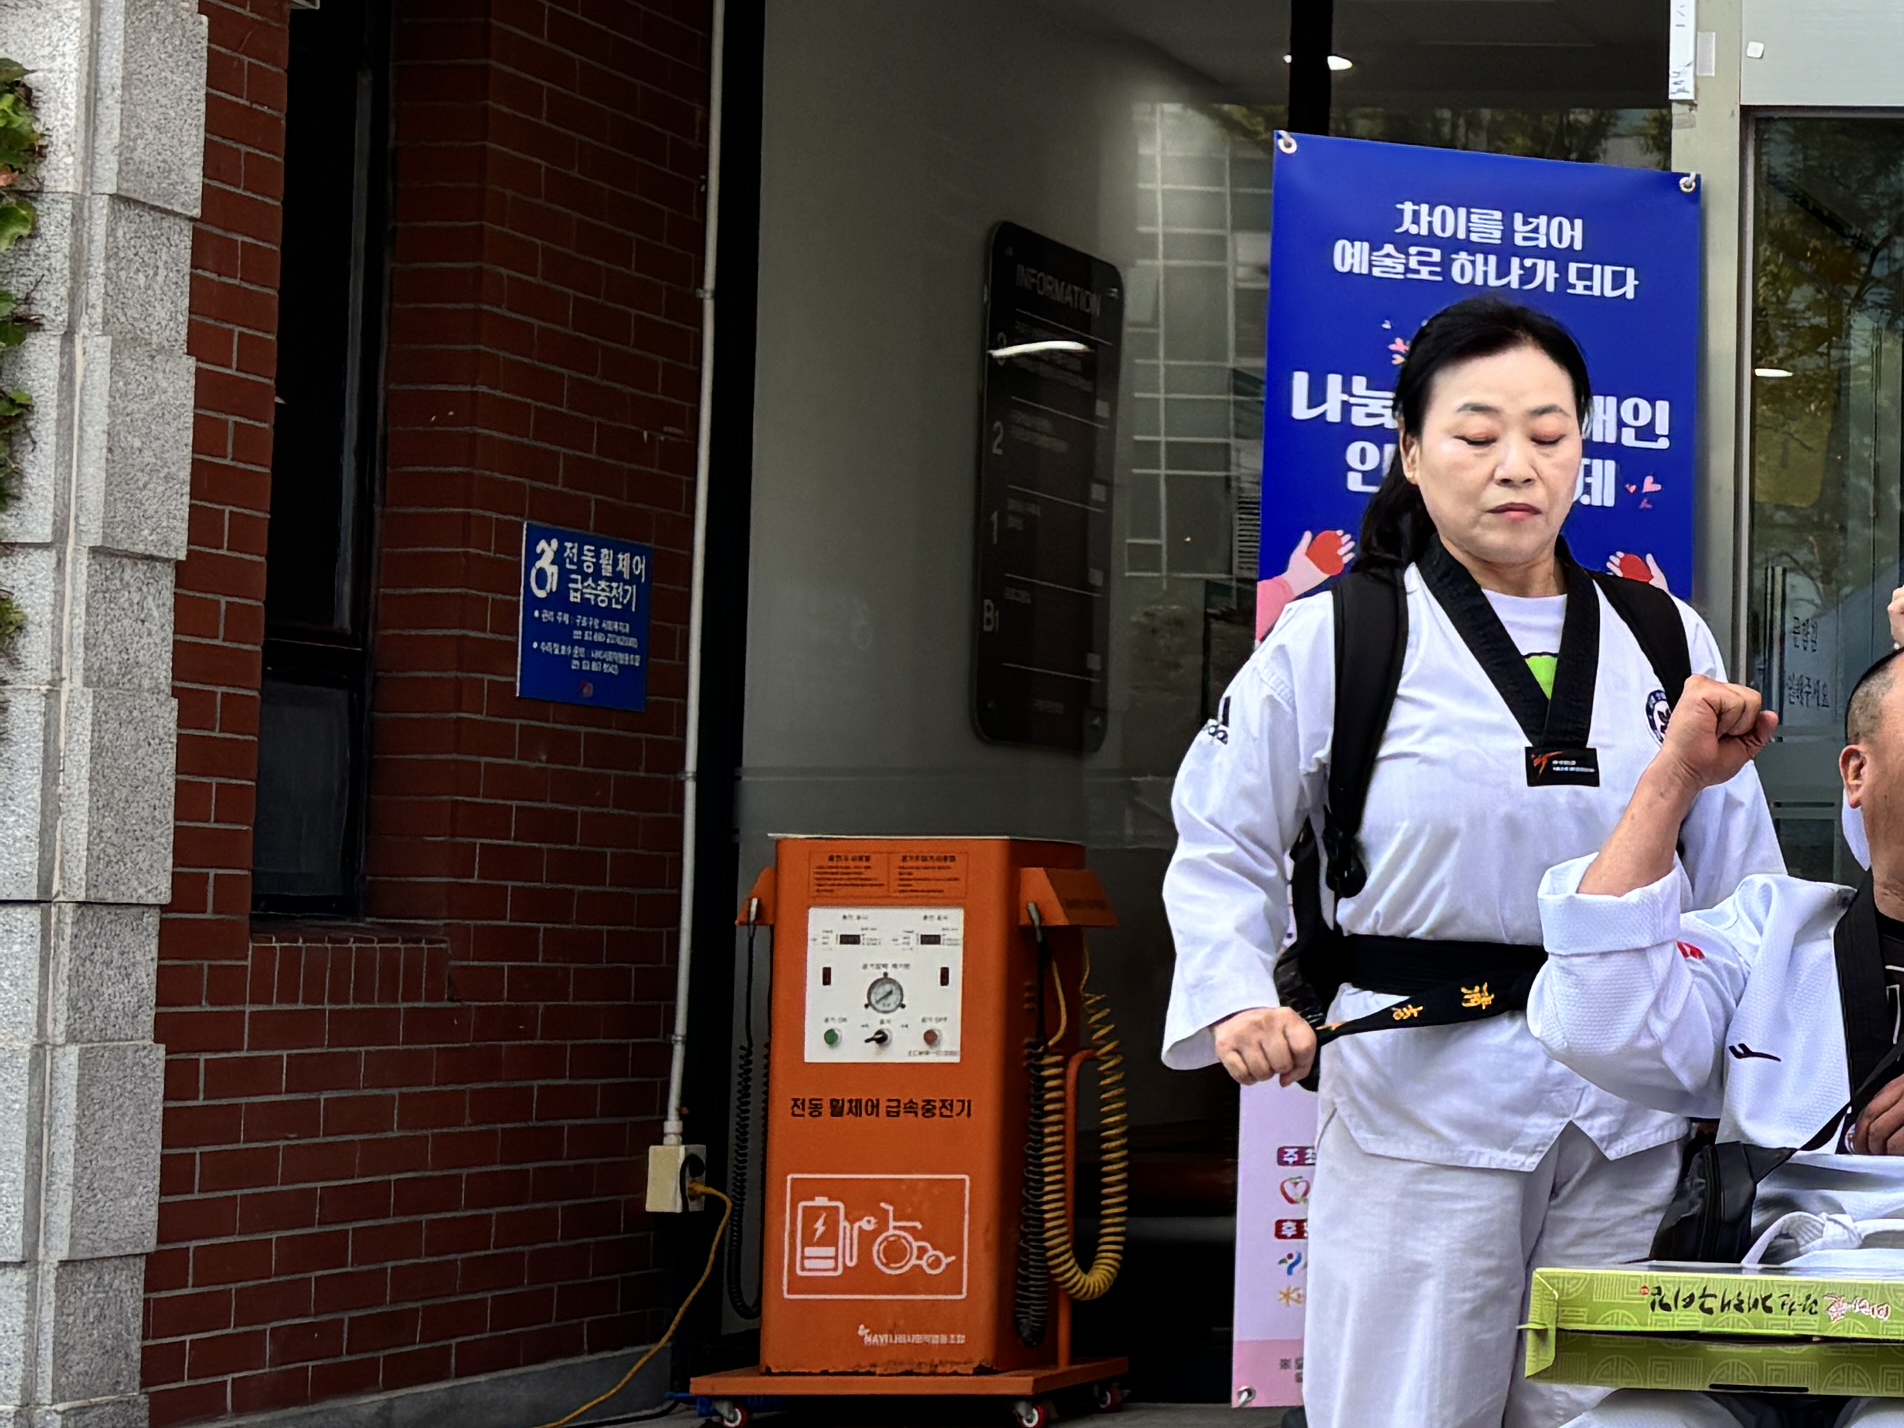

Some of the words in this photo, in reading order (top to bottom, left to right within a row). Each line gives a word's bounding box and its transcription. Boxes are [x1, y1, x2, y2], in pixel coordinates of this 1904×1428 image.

[1394, 200, 1503, 240] 차이를
[1512, 212, 1584, 251] 넘어
[1015, 262, 1102, 317] INFORMATION
[1332, 238, 1443, 283] 예술로
[1450, 251, 1560, 293] 하나가
[1566, 262, 1640, 300] 되다
[568, 574, 637, 612] 급속충전기
[790, 1097, 823, 1119] 전동
[829, 1097, 880, 1119] 휠체어
[885, 1098, 972, 1119] 급속충전기
